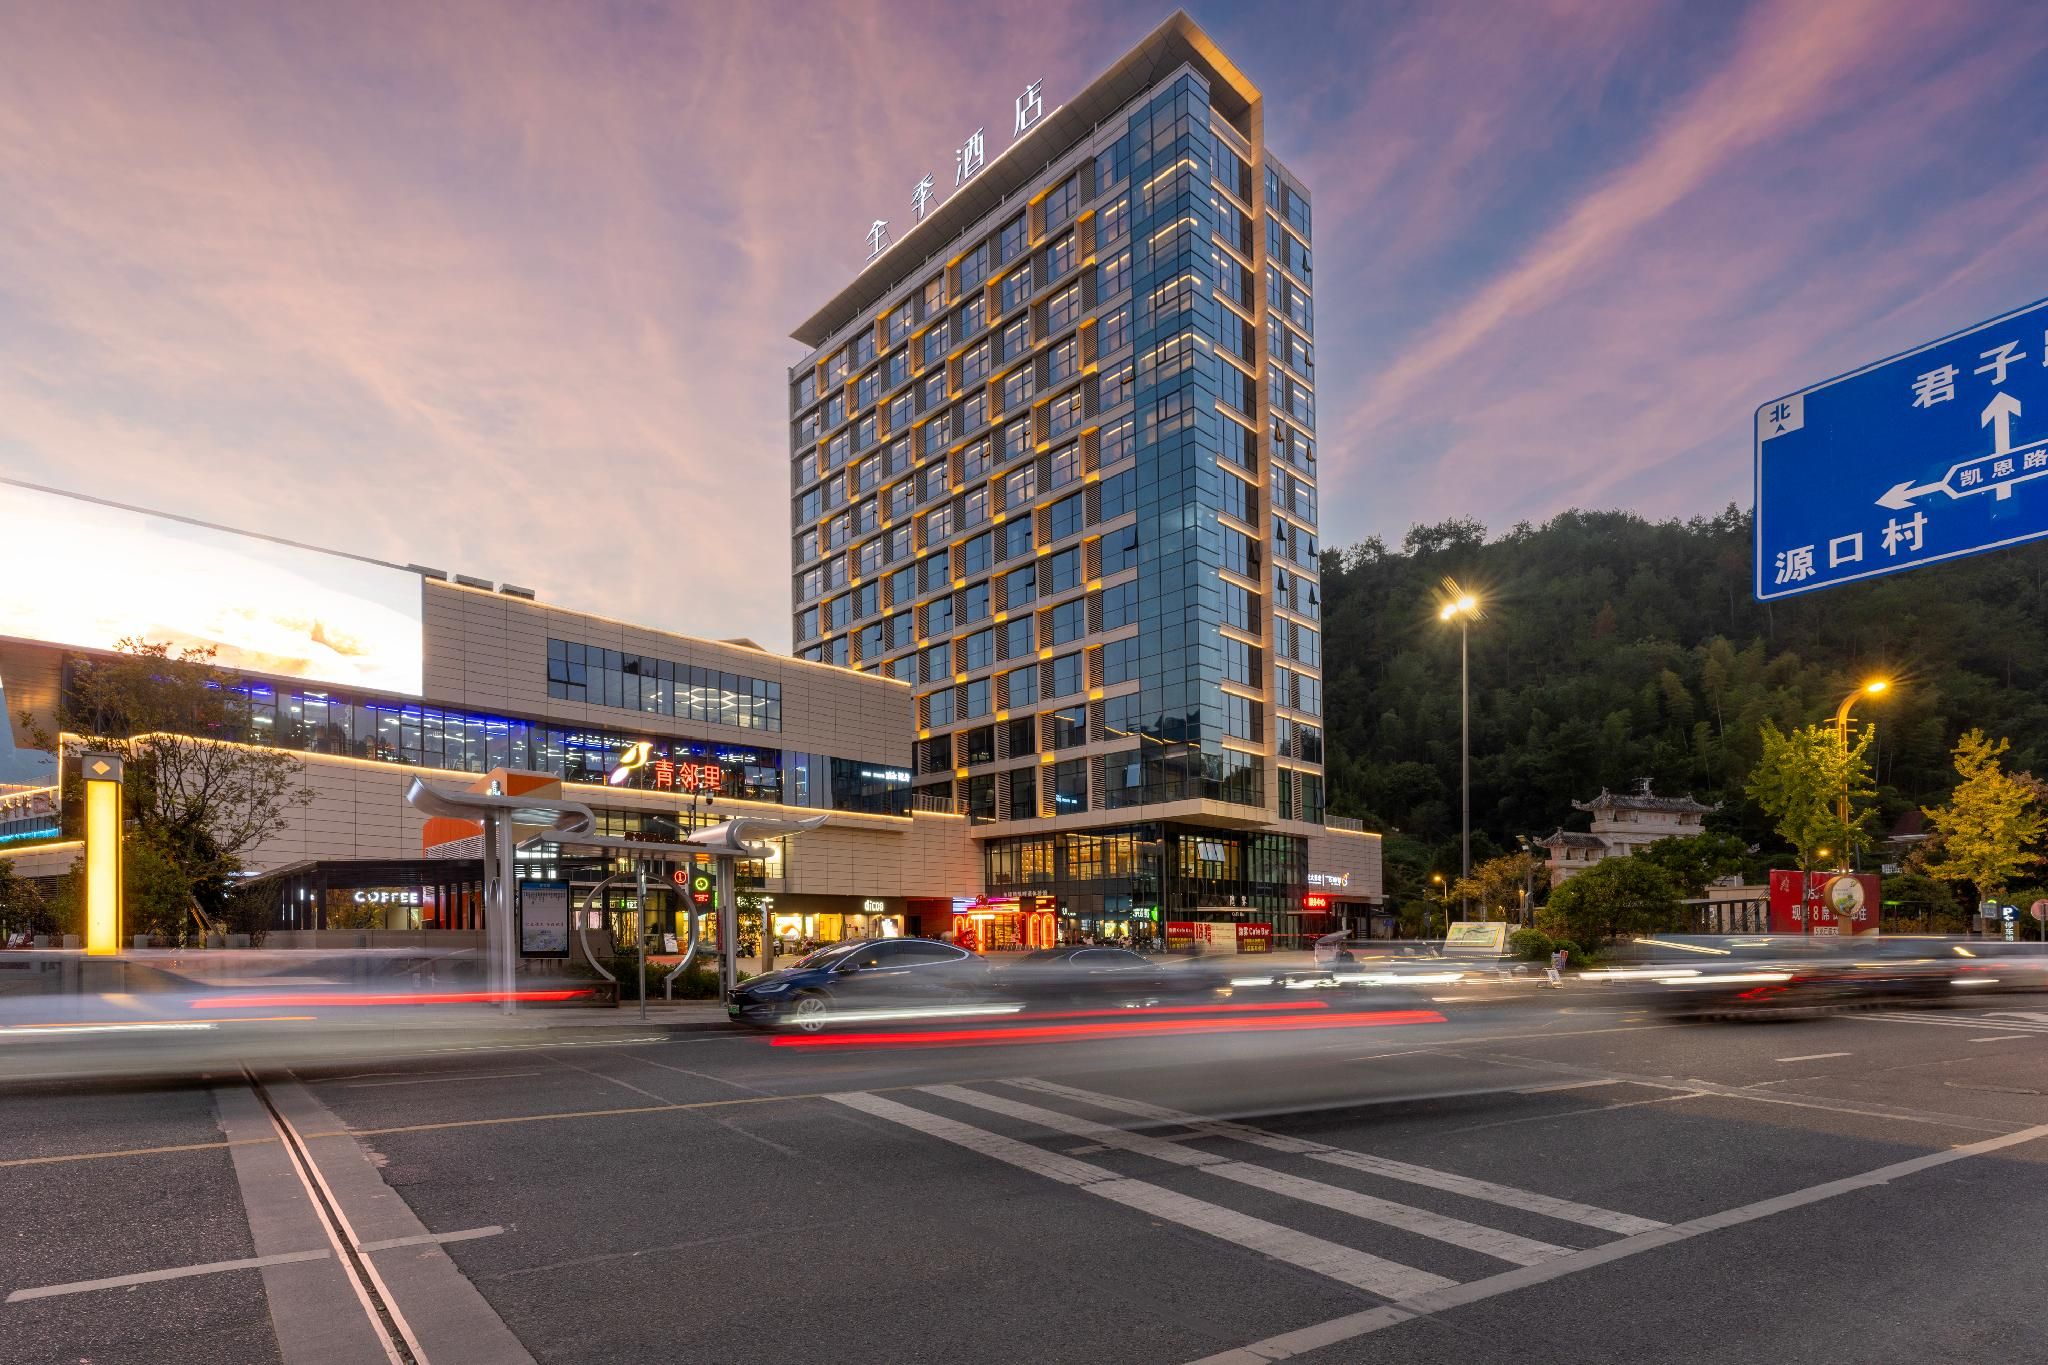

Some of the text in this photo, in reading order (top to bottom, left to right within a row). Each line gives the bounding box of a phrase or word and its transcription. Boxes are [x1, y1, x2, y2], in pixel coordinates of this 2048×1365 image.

[866, 77, 1044, 261] 全季酒店
[1911, 329, 2048, 408] 君子
[1769, 402, 1791, 424] 北
[1960, 449, 2048, 487] 凯恩路
[1775, 512, 1928, 585] 源口村
[655, 759, 721, 791] 青邻里
[354, 891, 418, 903] COFFEE
[2002, 907, 2013, 916] P
